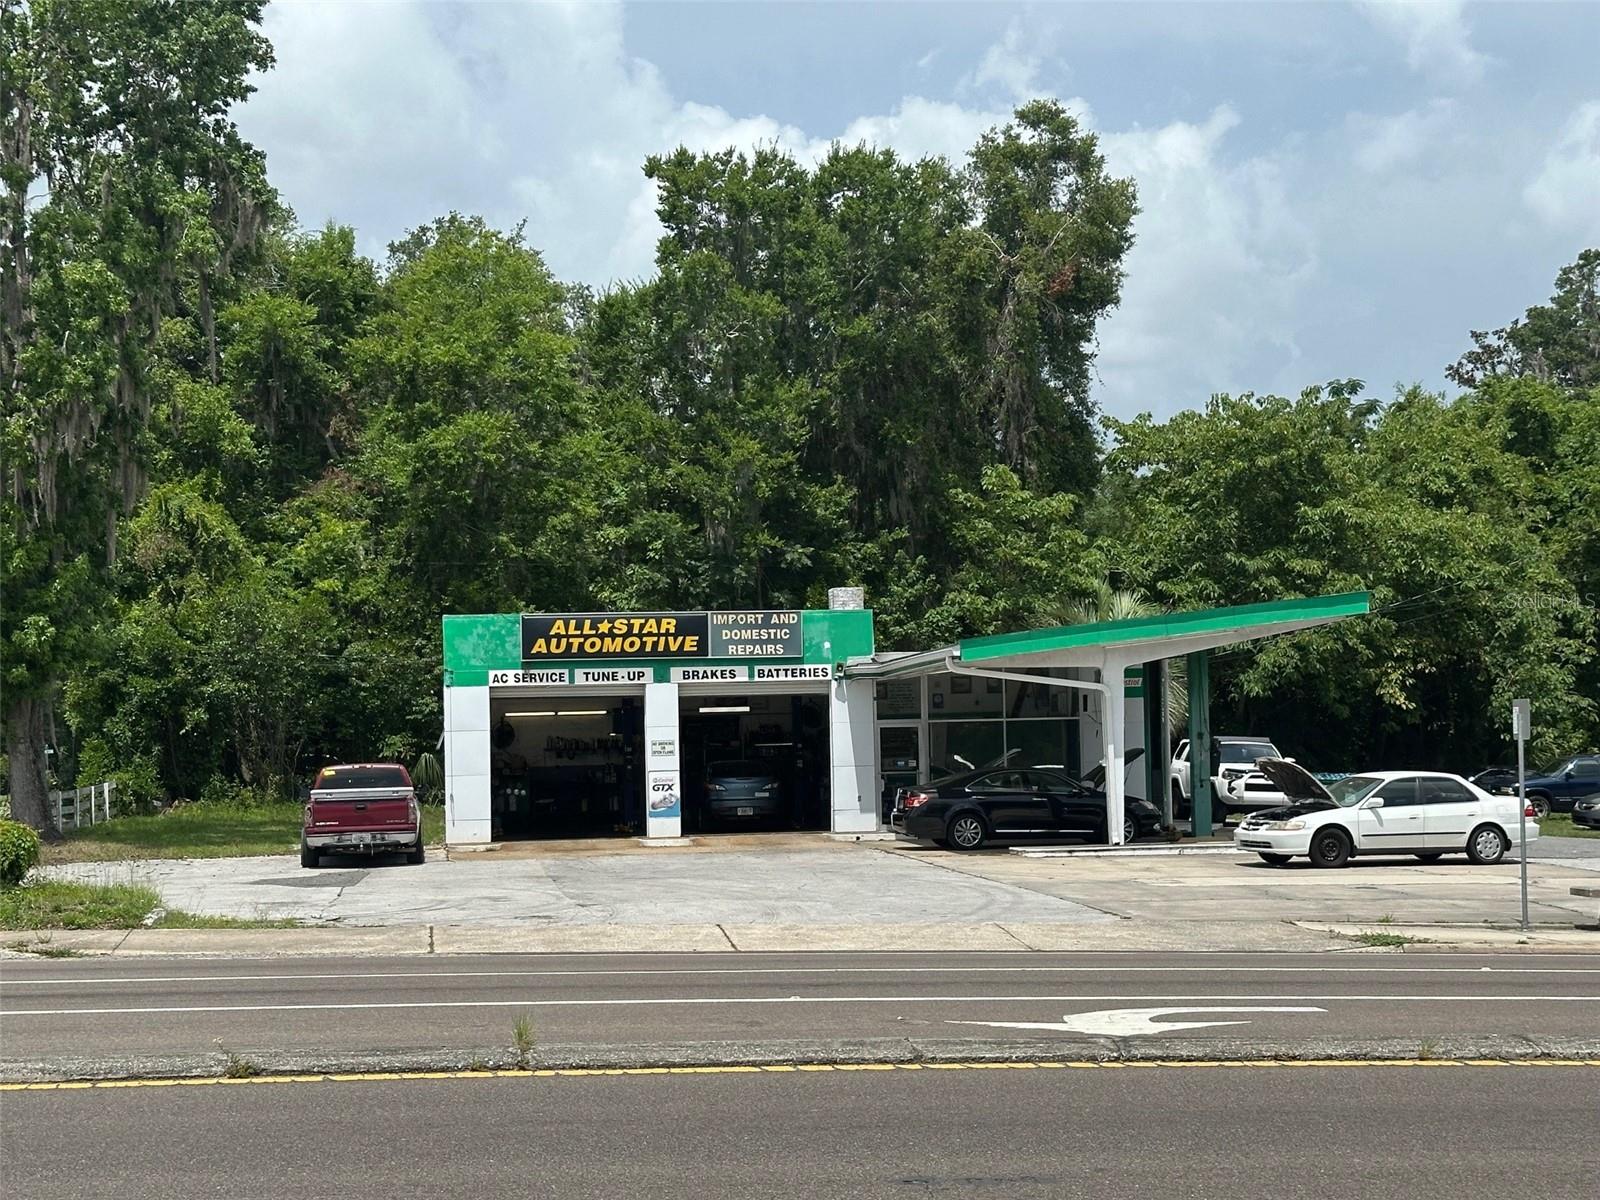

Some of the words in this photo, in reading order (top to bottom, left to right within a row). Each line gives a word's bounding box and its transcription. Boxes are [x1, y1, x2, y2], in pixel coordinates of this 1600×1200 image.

[713, 613, 764, 625] IMPORT
[770, 613, 798, 624] AND
[549, 618, 597, 635] ALL
[612, 617, 677, 635] STAR
[722, 628, 791, 640] DOMESTIC
[531, 635, 700, 654] AUTOMOTIVE
[728, 644, 784, 655] REPAIRS
[492, 673, 509, 684] AC
[513, 671, 566, 683] SERVICE
[583, 670, 646, 682] TUNE-UP
[682, 668, 737, 680] BRAKES
[757, 666, 829, 679] BATTERIES
[652, 783, 675, 792] GTX
